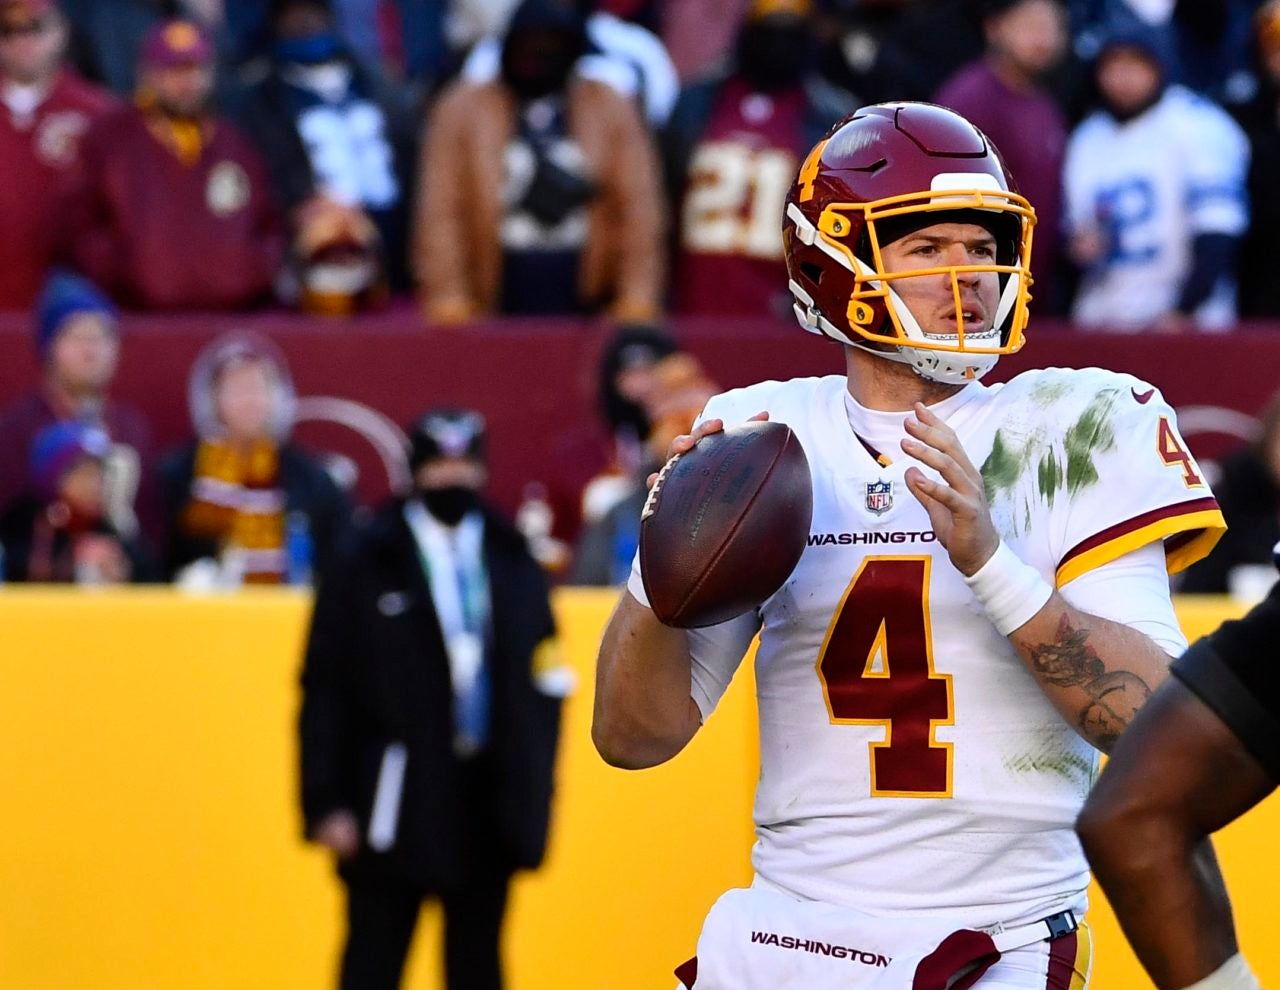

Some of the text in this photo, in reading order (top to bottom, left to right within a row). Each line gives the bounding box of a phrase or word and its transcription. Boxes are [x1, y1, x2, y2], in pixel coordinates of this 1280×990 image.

[682, 143, 794, 258] 21
[798, 139, 830, 203] 4
[1156, 415, 1204, 488] 4
[868, 493, 889, 509] NFL
[807, 530, 938, 547] WASHINGTO
[815, 554, 955, 797] 4
[751, 931, 893, 968] WASHINGTON
